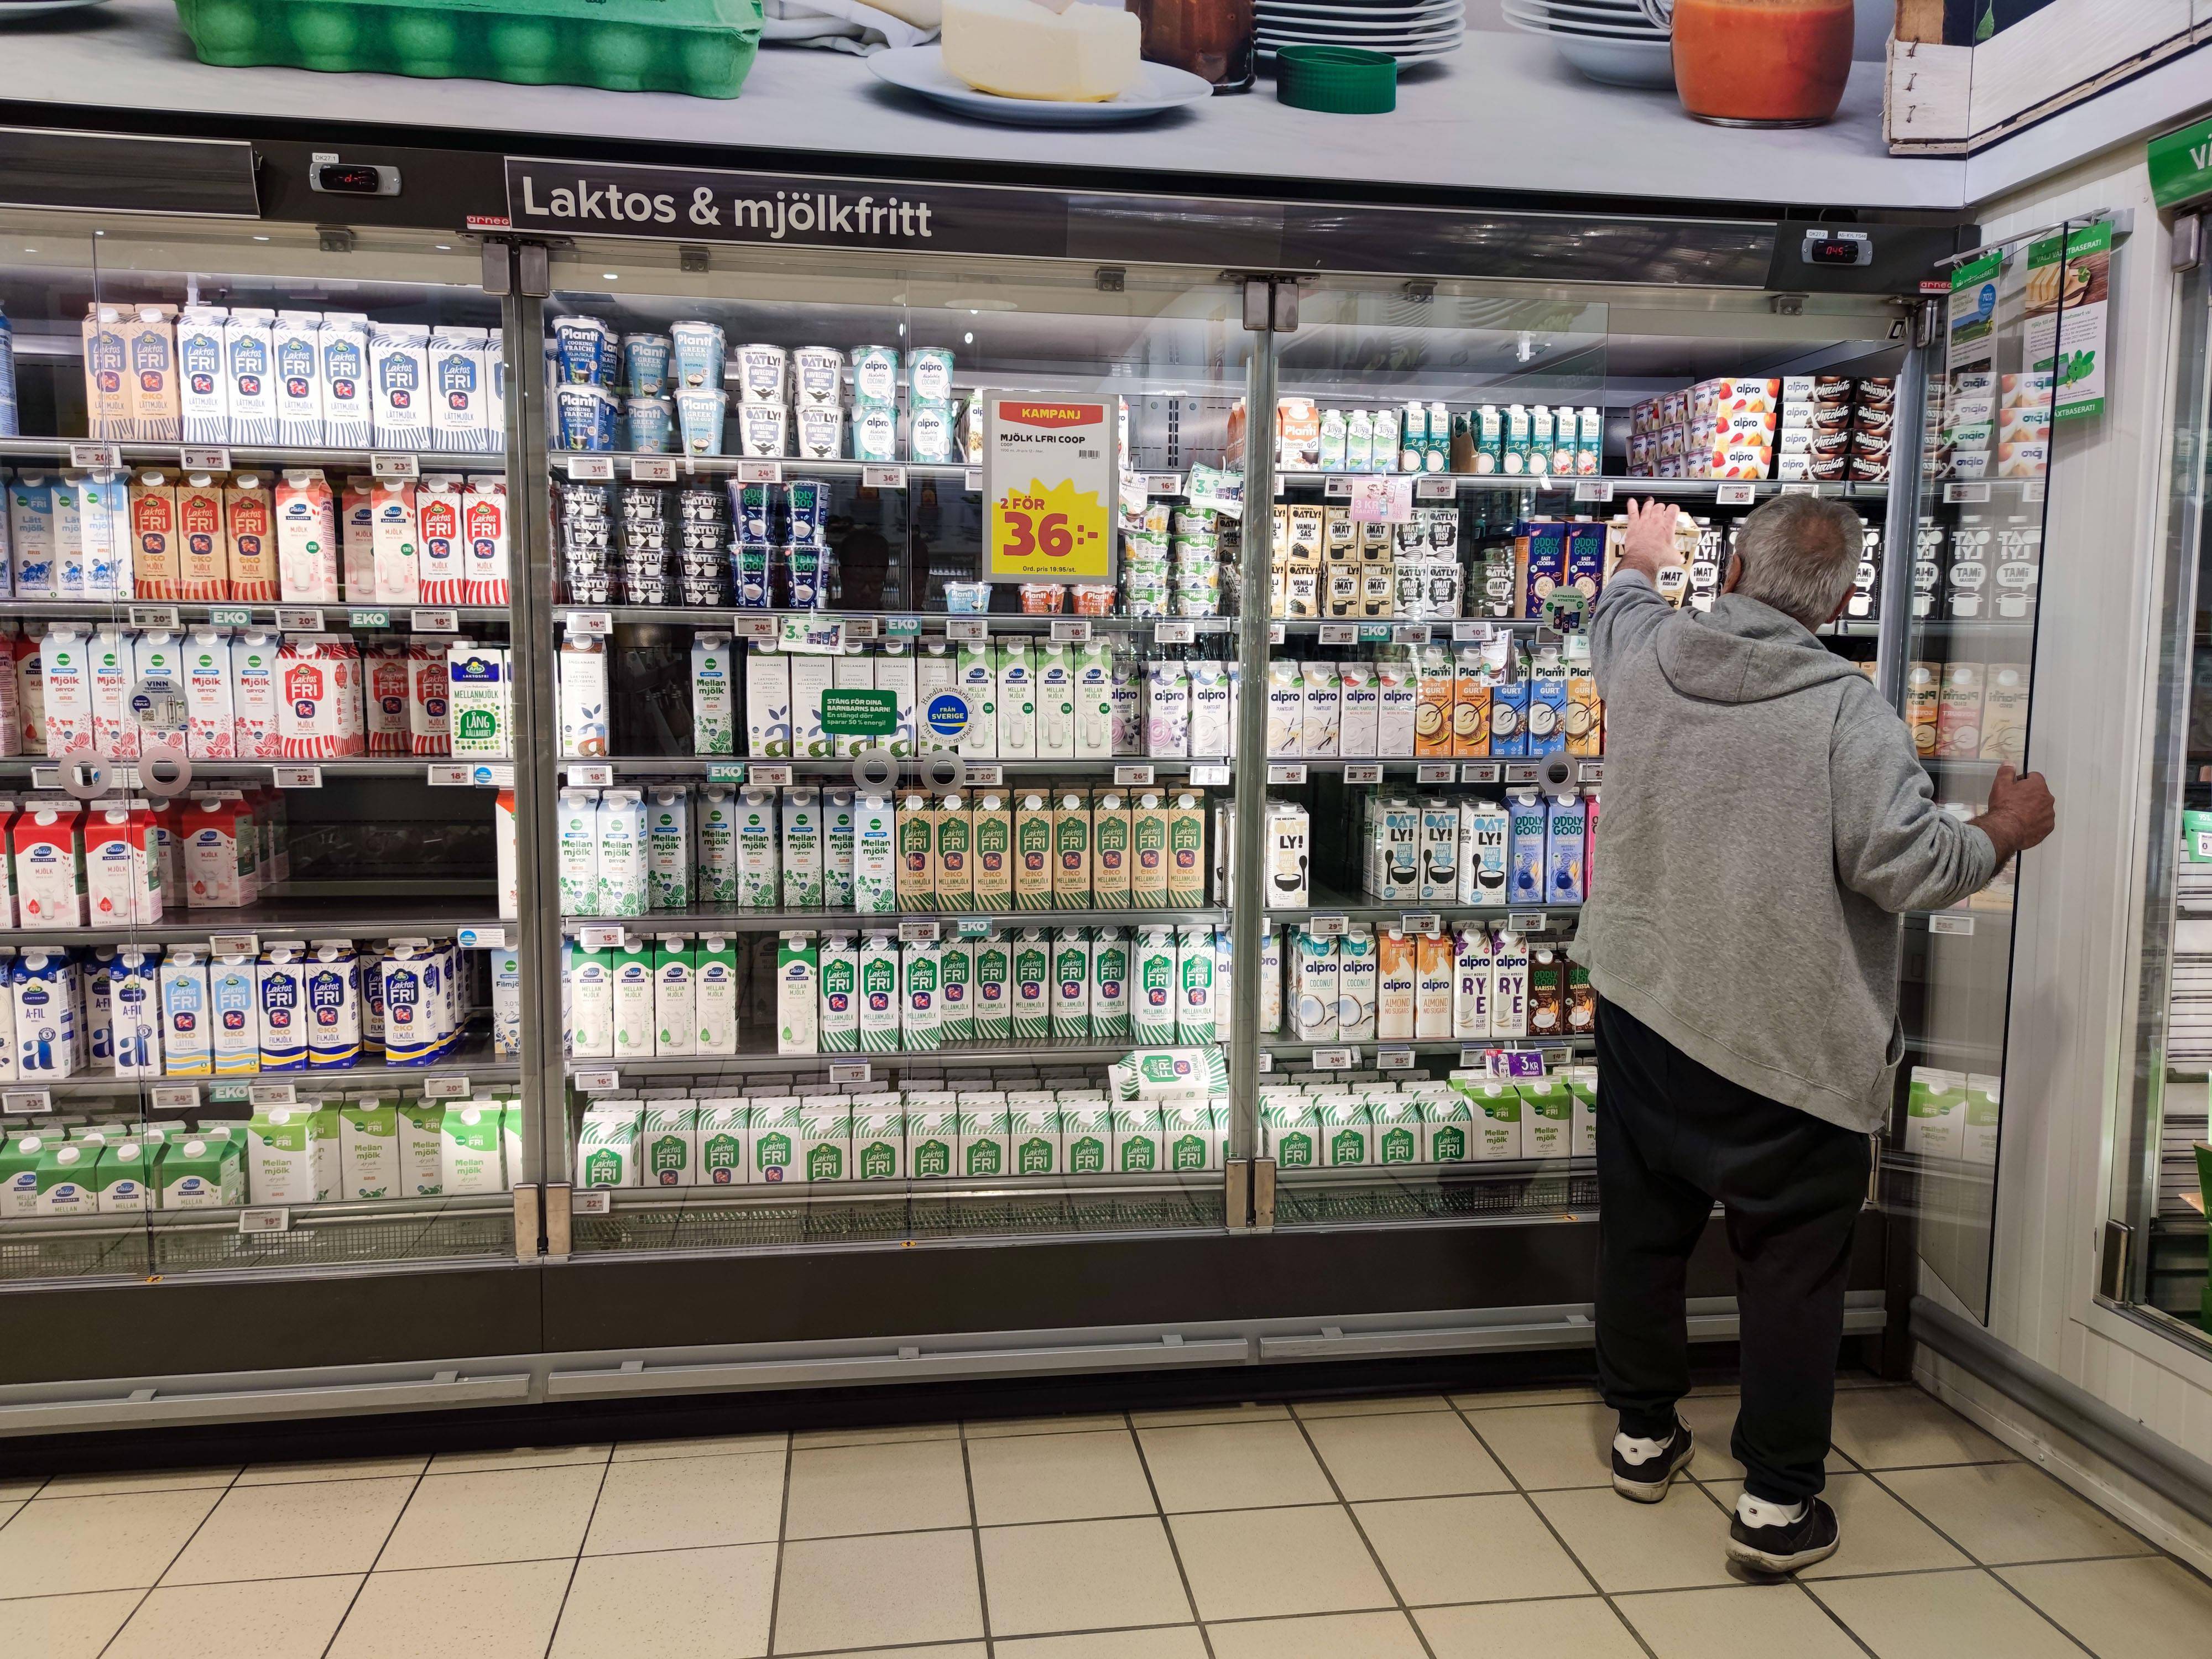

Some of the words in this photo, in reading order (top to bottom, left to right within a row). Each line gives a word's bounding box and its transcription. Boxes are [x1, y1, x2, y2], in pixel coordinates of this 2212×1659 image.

[522, 176, 676, 223] Laktos
[688, 187, 722, 225] &
[734, 191, 932, 239] mjölkfritt
[562, 328, 599, 341] Planti
[677, 334, 712, 347] Planti
[138, 345, 163, 353] Laktos
[138, 354, 163, 368] FRI
[745, 355, 780, 367] OATLY!
[386, 363, 412, 373] Laktos
[444, 365, 470, 374] Laktos
[865, 362, 888, 373] alpro
[920, 362, 942, 373] alpro
[386, 373, 413, 387] FRI
[445, 375, 470, 389] FRI
[1736, 383, 1760, 395] alpro
[1787, 383, 1809, 393] alpro
[139, 400, 168, 409] LÄTTMJÖLK
[387, 410, 416, 419] LÄTTMJÖLK
[445, 412, 474, 421] LÄTTMJÖLK
[1022, 408, 1081, 420] KAMPANJ
[2054, 404, 2095, 418] ÄXTBASERAT!
[867, 418, 889, 429] alpro
[1734, 418, 1757, 430] alpro
[1285, 424, 1316, 436] Planti
[1000, 433, 1032, 442] MJÖLK
[1730, 452, 1754, 464] alpro
[1782, 460, 1804, 471] alpro
[1000, 498, 1008, 509] 2
[1013, 496, 1045, 510] FÖR
[1355, 500, 1363, 510] 3
[1364, 500, 1378, 509] KR
[187, 508, 213, 517] Laktos
[471, 513, 497, 523] Laktos
[1293, 509, 1321, 519] OATLY!
[1430, 512, 1457, 521] OATLY!
[19, 524, 45, 533] mjölk
[187, 518, 213, 532] FRI
[472, 523, 497, 537] FRI
[1003, 512, 1098, 557] 36:-
[1436, 532, 1449, 540] VISP
[1533, 546, 1559, 555] GOOD
[194, 564, 210, 572] MJÖLK
[213, 612, 247, 624] EKO
[353, 613, 385, 624] EKO
[889, 619, 917, 630] EKO
[785, 624, 796, 639] 3
[1360, 626, 1387, 637] EKO
[1536, 667, 1565, 677] Planti
[50, 676, 80, 686] Mjölk
[241, 677, 270, 686] Mjölk
[291, 674, 317, 684] Laktos
[291, 684, 317, 698] FRI
[454, 690, 499, 699] MELLANMJÖLK
[699, 687, 724, 696] mjölk
[921, 687, 943, 705] Handla
[945, 687, 973, 703] utmärkt!
[1198, 692, 1226, 701] alpro
[1308, 691, 1337, 703] alpro
[1347, 691, 1376, 703] alpro
[297, 721, 315, 729] MJÖLK
[466, 712, 490, 728] LÅNG
[922, 723, 933, 738] Titta
[953, 723, 974, 743] märket!
[711, 766, 742, 777] EKO
[942, 829, 966, 838] Laktos
[1390, 829, 1413, 842] LY!
[1553, 826, 1583, 836] GOOD
[651, 834, 681, 842] Mellan
[653, 841, 680, 851] mjölk
[942, 838, 966, 850] FRI
[1306, 962, 1337, 975] alpro
[390, 980, 414, 990] Laktos
[1147, 974, 1168, 987] FRI
[1310, 978, 1334, 988] COCONUT
[1383, 980, 1411, 993] alpro
[390, 989, 414, 1004] FRI
[1385, 997, 1410, 1008] ALMOND
[25, 1008, 46, 1019] A-FIL
[1520, 1056, 1529, 1070] 3
[1530, 1062, 1539, 1070] KR
[657, 1145, 681, 1154] Laktos
[357, 1151, 380, 1160] mjölk
[657, 1154, 681, 1167] FRI
[55, 1205, 77, 1213] MELLAN
